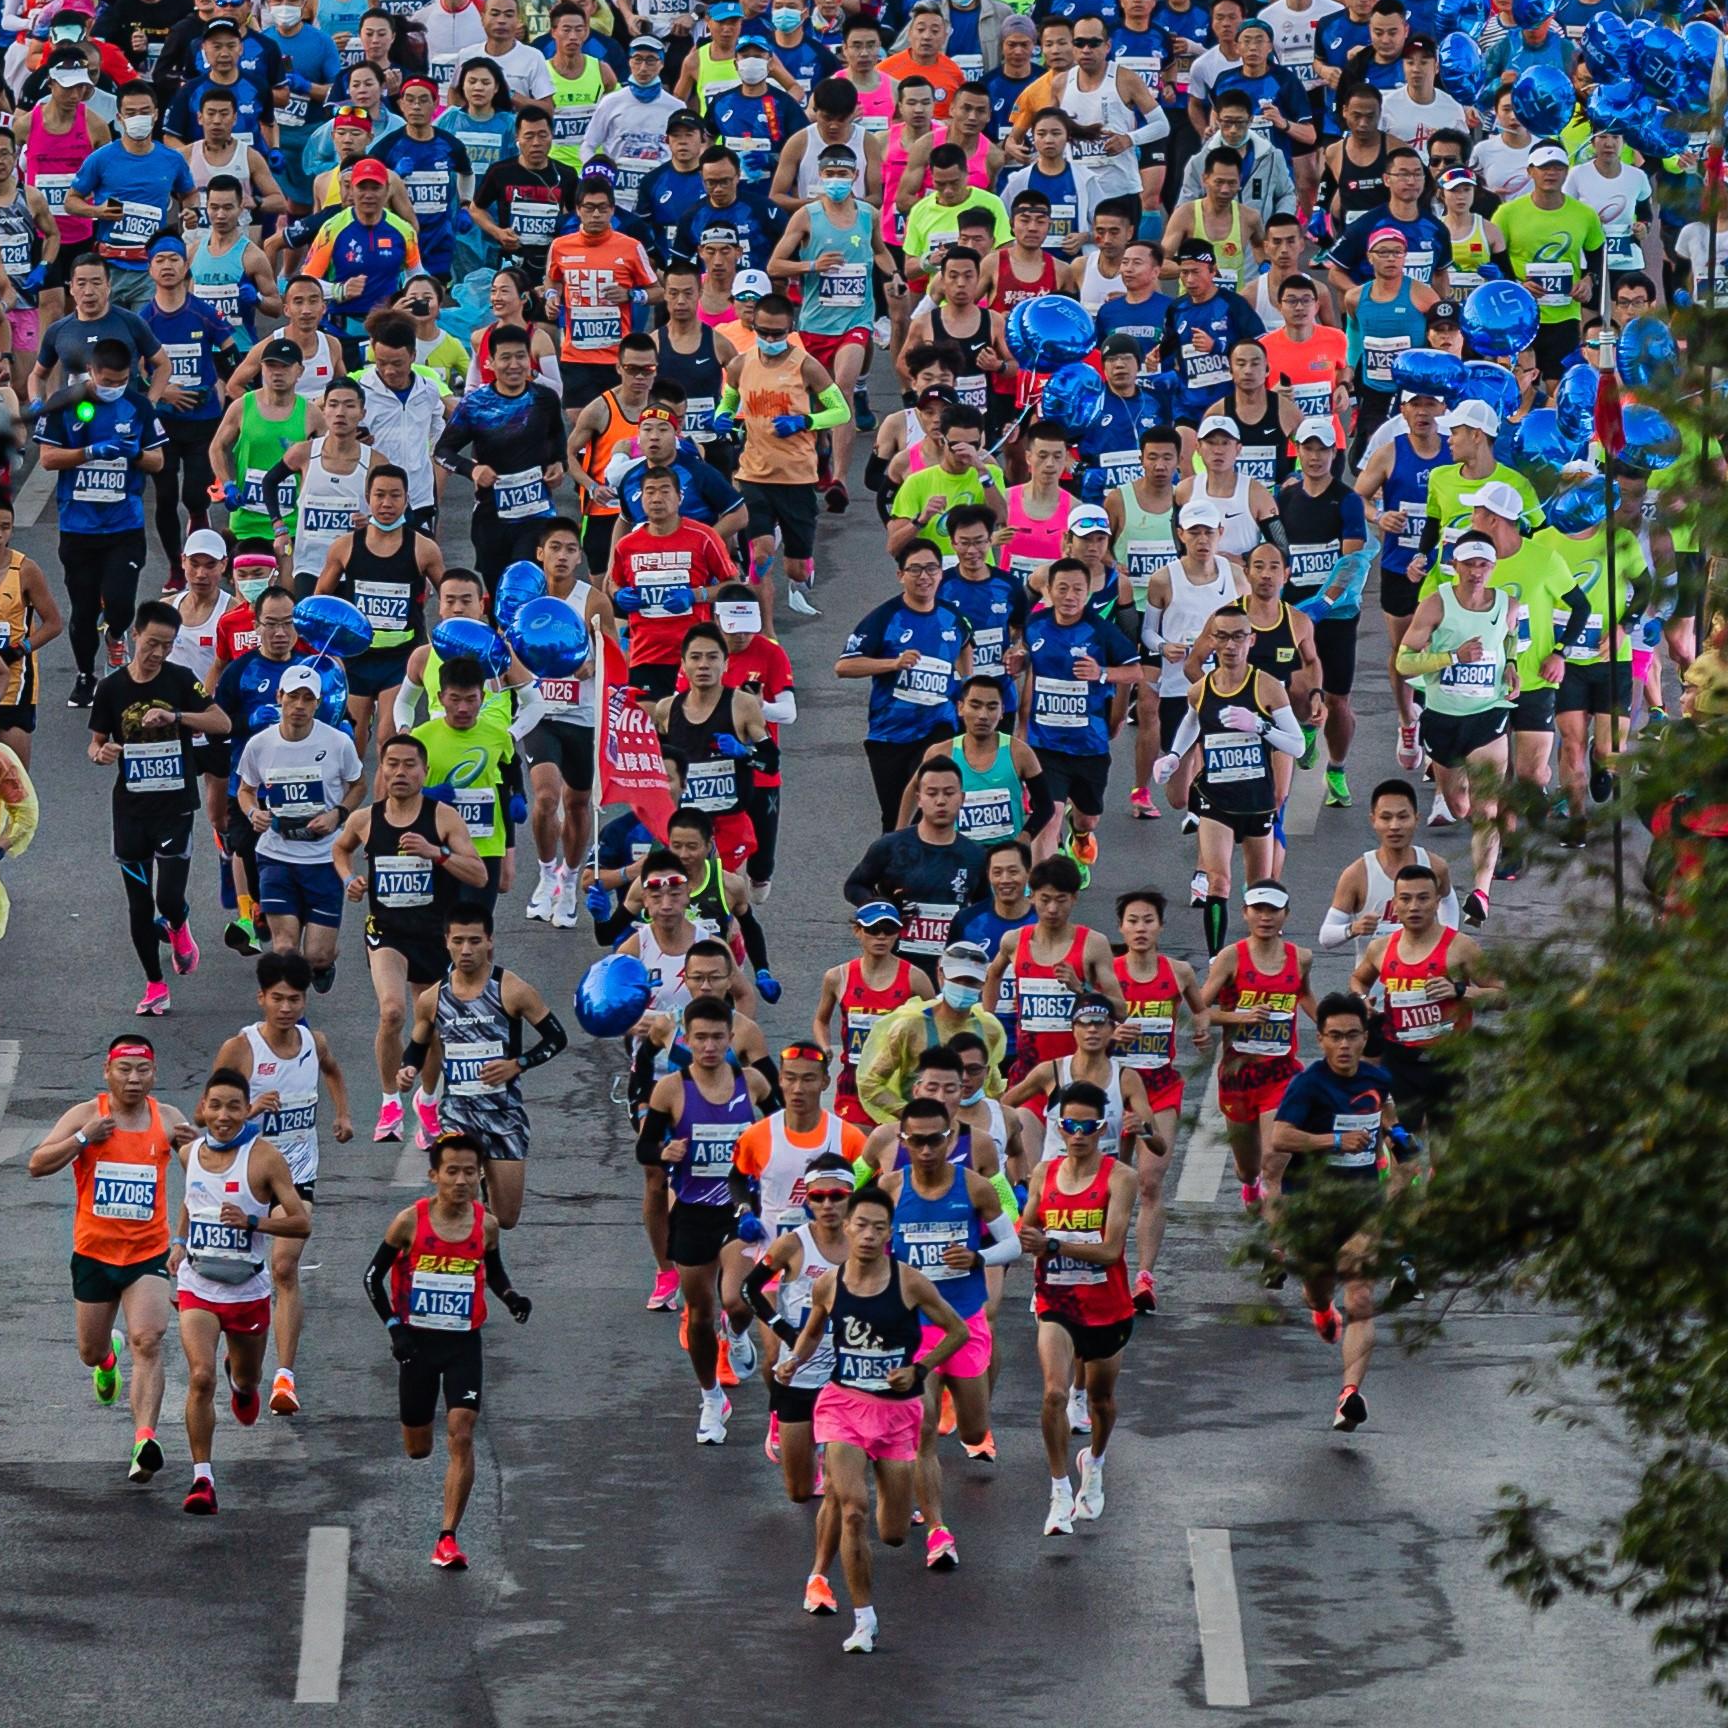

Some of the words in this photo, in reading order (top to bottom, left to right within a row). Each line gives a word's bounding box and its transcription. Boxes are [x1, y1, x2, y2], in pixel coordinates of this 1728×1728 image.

[821, 275, 866, 297] A16235
[572, 319, 621, 337] A10872
[1186, 355, 1230, 375] A16804
[75, 471, 125, 490] A14480
[245, 487, 293, 505] A101
[499, 485, 543, 506] A12157
[357, 596, 408, 618] A16972
[899, 670, 948, 692] A15008
[1442, 664, 1495, 686] A13804
[1037, 694, 1086, 715] A10009
[129, 755, 180, 779] A15831
[1208, 747, 1262, 769] A10848
[282, 784, 308, 801] 102
[959, 804, 1011, 826] A12804
[378, 874, 431, 893] A17057
[1022, 995, 1075, 1019] A18657
[1401, 1003, 1441, 1027] A1119
[264, 1109, 315, 1134] A12854
[96, 1184, 155, 1206] A17085
[192, 1227, 249, 1249] A13515
[415, 1294, 472, 1315] A11521
